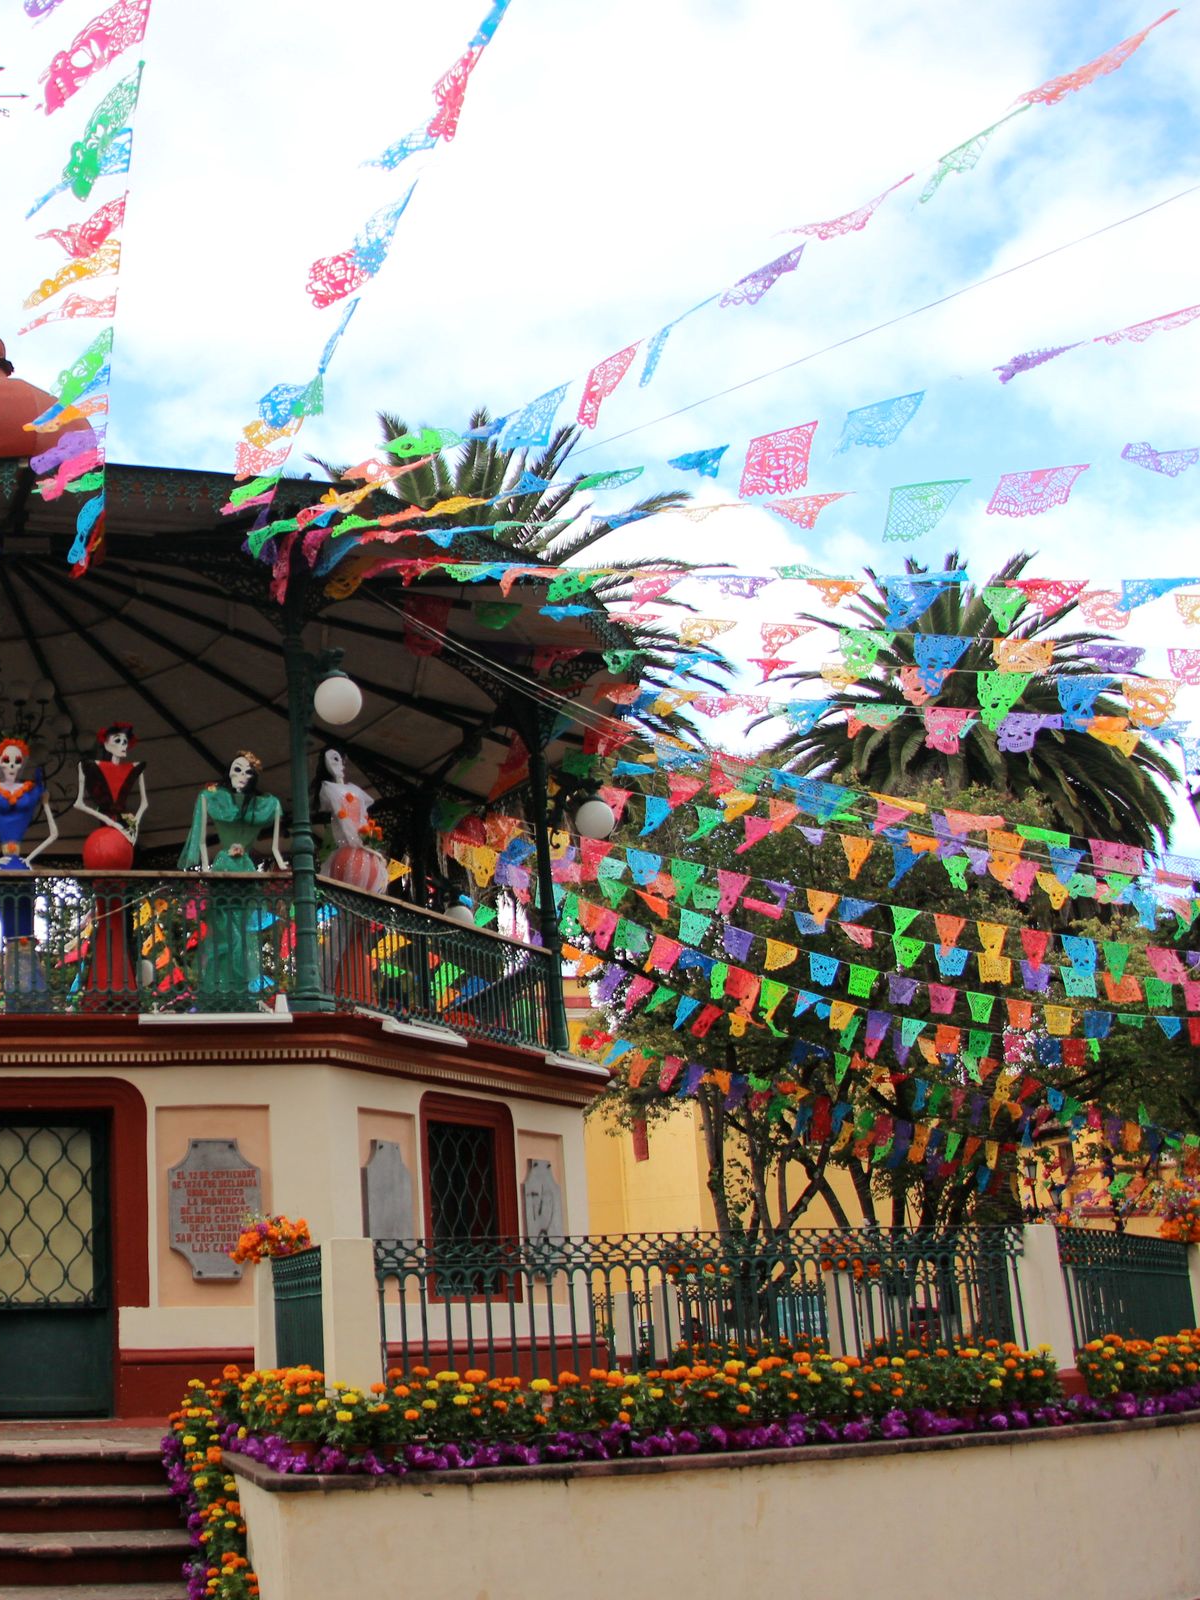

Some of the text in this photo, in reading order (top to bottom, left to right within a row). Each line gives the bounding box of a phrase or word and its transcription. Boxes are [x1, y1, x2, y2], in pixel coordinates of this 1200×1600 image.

[177, 1171, 185, 1180] EL
[172, 1180, 181, 1189] DE
[187, 1197, 246, 1206] LA PROVINCIA
[180, 1206, 191, 1215] DE
[194, 1206, 211, 1215] LAS
[180, 1215, 211, 1224] SIENDO
[189, 1224, 200, 1232] DE
[204, 1224, 214, 1232] LA
[175, 1233, 192, 1243] SAN
[191, 1243, 210, 1253] LAS
